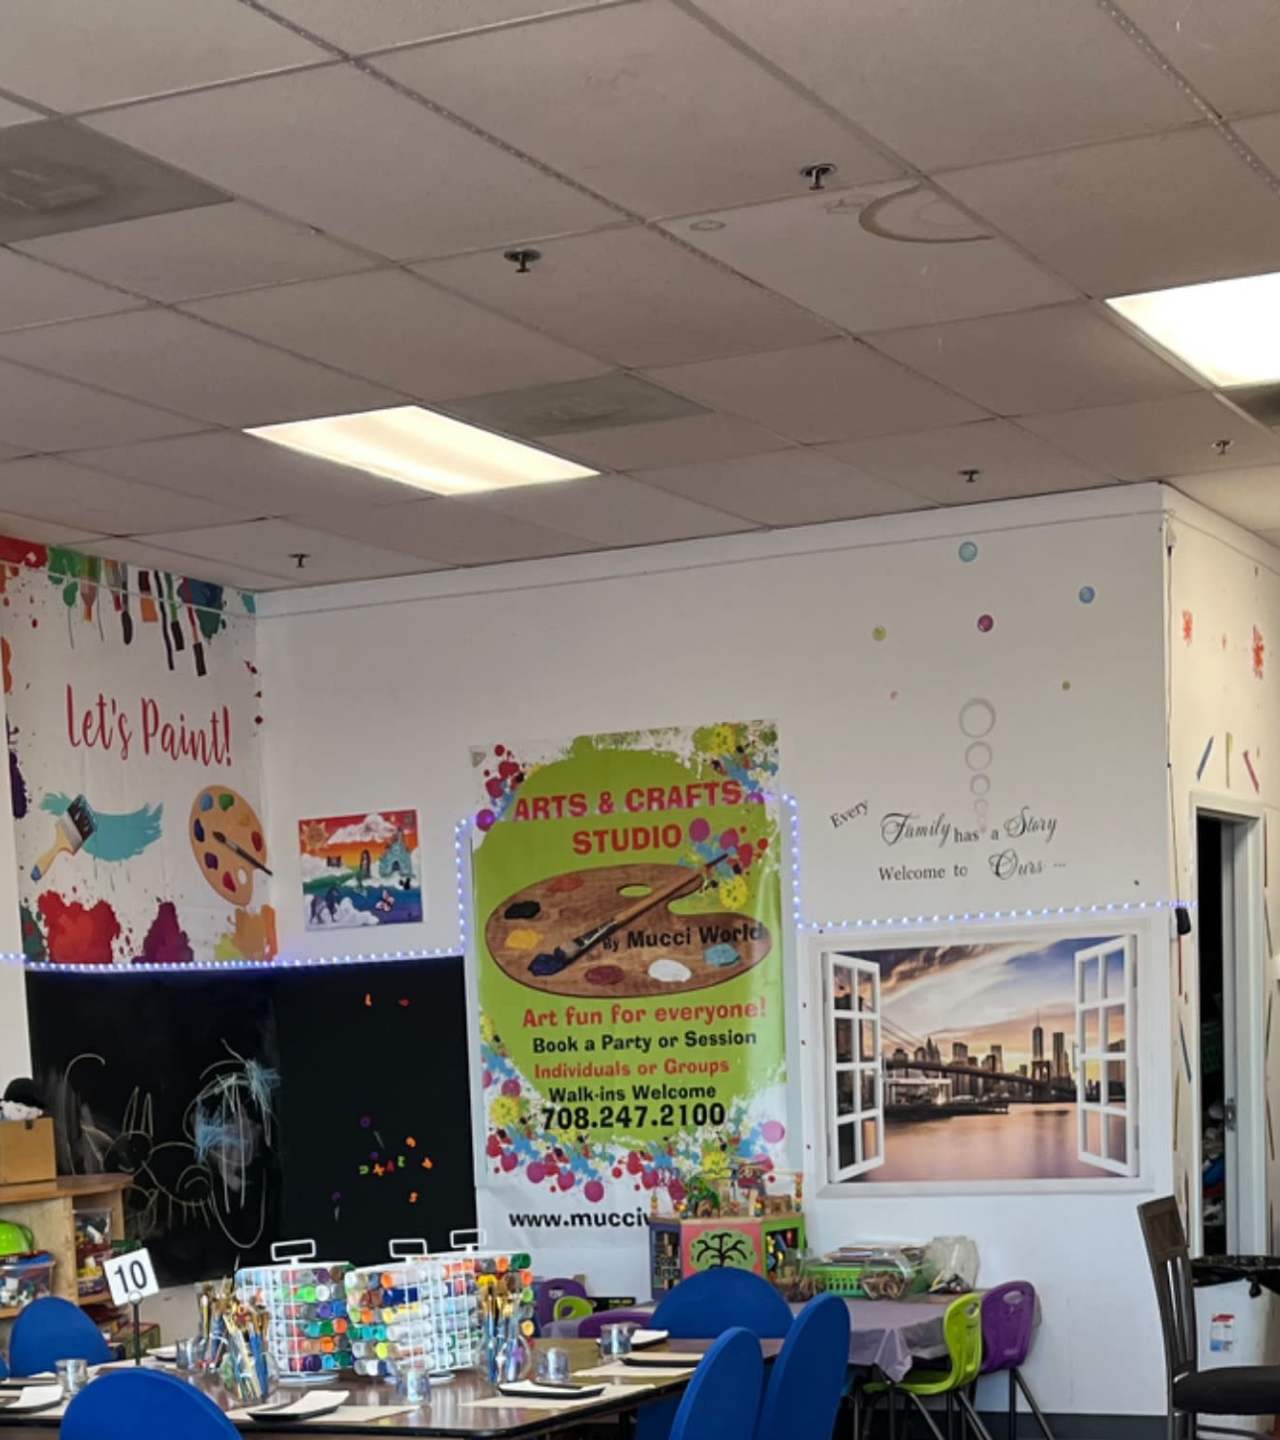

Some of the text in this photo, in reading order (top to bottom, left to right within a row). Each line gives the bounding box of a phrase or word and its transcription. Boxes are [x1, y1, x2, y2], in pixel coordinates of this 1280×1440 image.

[66, 684, 233, 766] Let's Paint!
[513, 780, 743, 822] ARTS & CRAFTS
[830, 800, 869, 828] Every
[572, 824, 683, 855] STUDIO
[880, 806, 1058, 848] Family has a Story
[878, 865, 946, 882] Welcome
[953, 863, 969, 878] to
[602, 922, 767, 952] By Mucci World
[523, 997, 767, 1028] Art fun for everyone!
[533, 1030, 758, 1053] Book a Party or Session
[534, 1058, 730, 1080] Individuals or Groups
[549, 1084, 717, 1104] Walk-ins Welcome
[542, 1103, 726, 1130] 708.247.2100
[113, 1259, 148, 1293] 10
